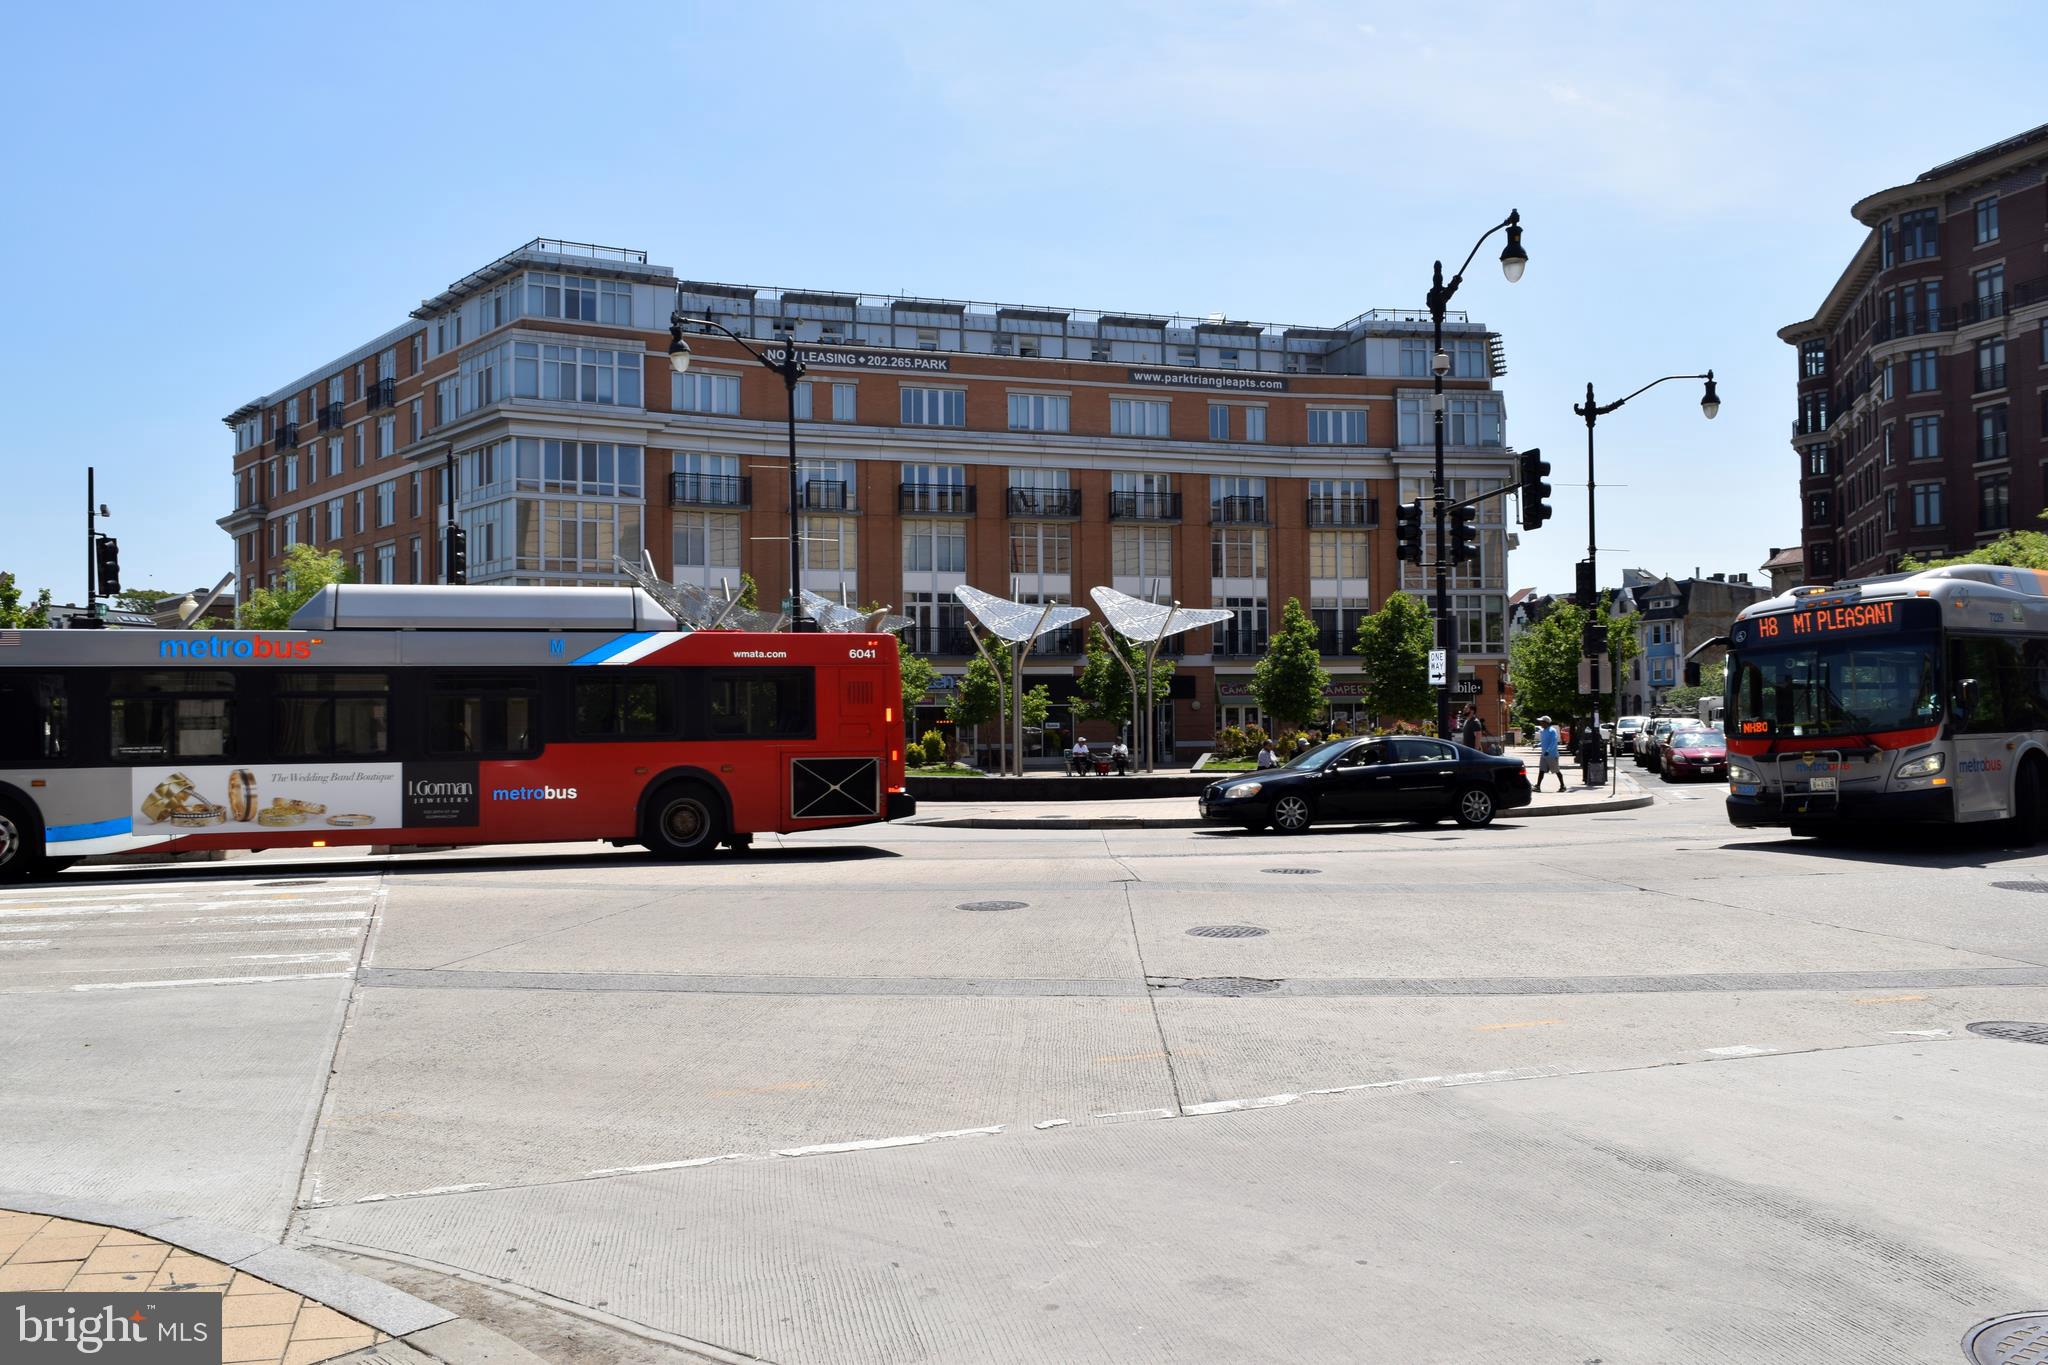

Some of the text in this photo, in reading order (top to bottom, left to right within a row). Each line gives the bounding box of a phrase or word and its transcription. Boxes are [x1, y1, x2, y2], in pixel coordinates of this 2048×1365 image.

[801, 351, 856, 365] LEASING
[867, 355, 948, 370] 202.265.PARK
[1134, 371, 1283, 389] www.parktriangleapts.com
[1759, 602, 1894, 638] H8 MT PLEASANT
[159, 635, 311, 659] metrobus
[550, 639, 565, 656] M
[733, 650, 787, 659] wmata.com
[849, 649, 876, 659] 6041
[1431, 652, 1444, 661] ONE
[1431, 662, 1444, 670] WAY
[1959, 757, 2002, 773] metrobus
[271, 771, 394, 785] The Wedding Band Boutique
[493, 785, 578, 800] metrobus
[414, 796, 469, 805] JEWELERS
